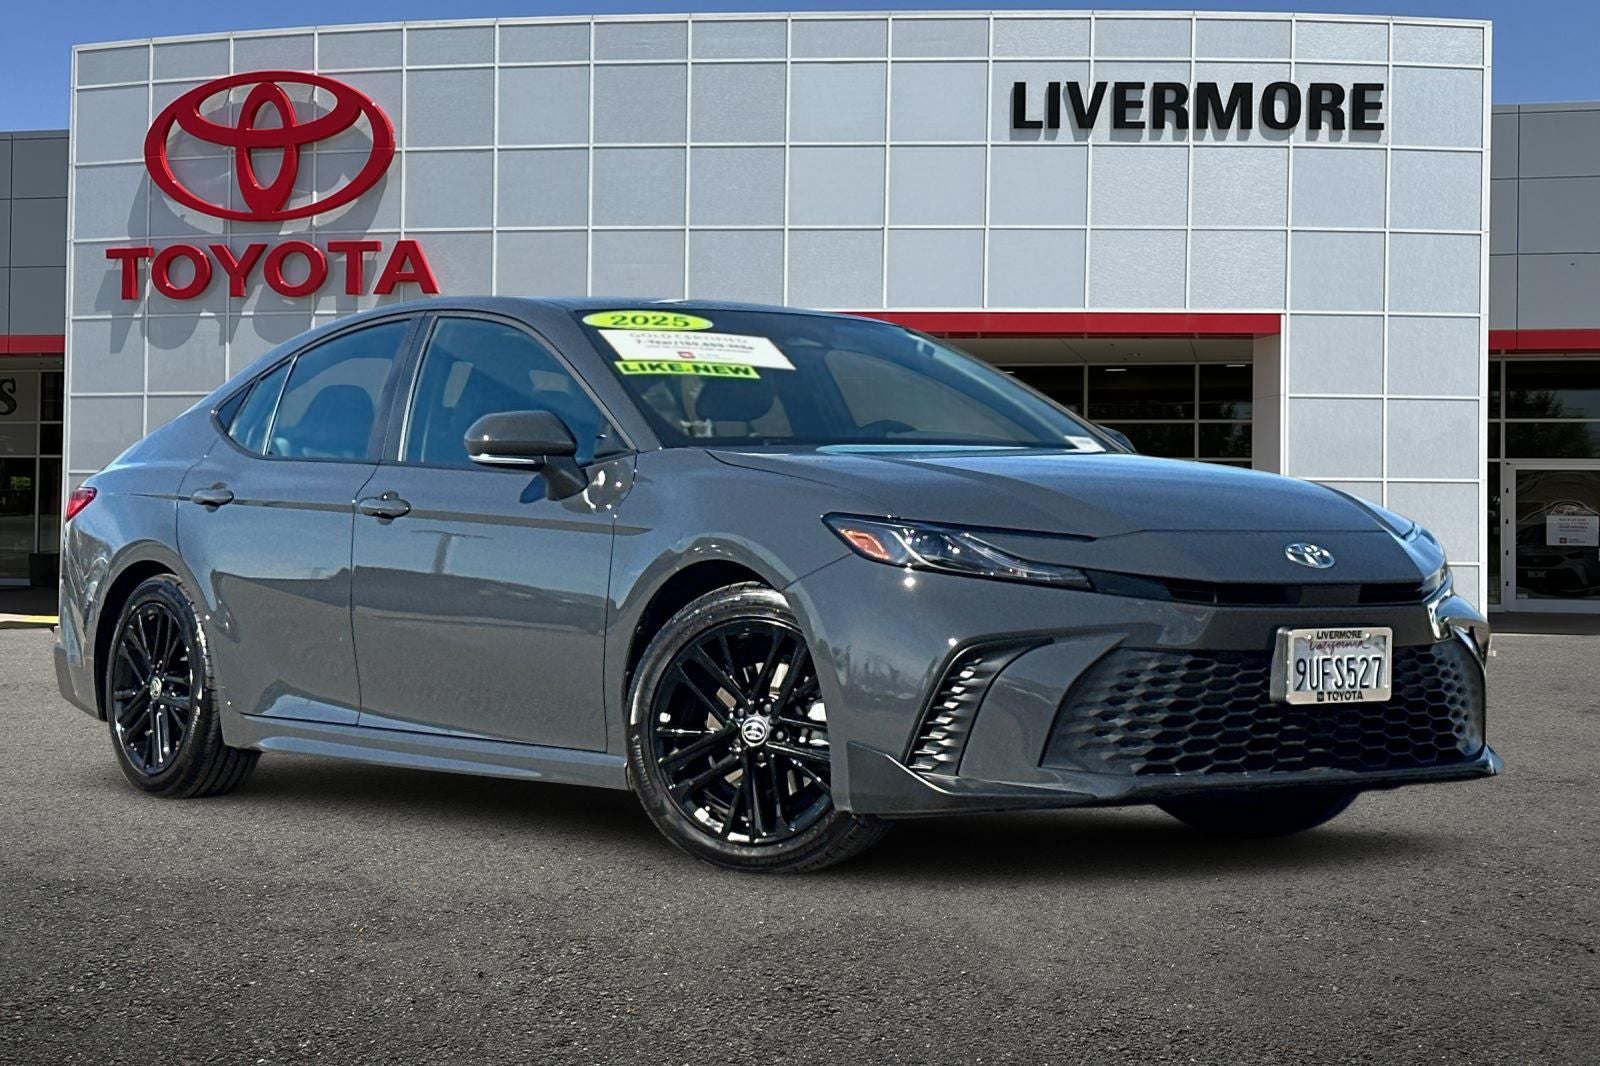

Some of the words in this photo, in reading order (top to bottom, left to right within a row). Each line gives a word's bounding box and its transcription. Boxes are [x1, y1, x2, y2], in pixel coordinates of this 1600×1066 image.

[1012, 81, 1385, 131] LIVERMORE
[105, 240, 440, 300] TOYOTA
[610, 315, 690, 327] 2025
[621, 362, 683, 372] LIKE
[691, 364, 751, 375] NEW
[1316, 630, 1363, 639] LIVERMORE
[1309, 640, 1370, 655] California
[1296, 657, 1382, 691] 9UFS527
[1326, 690, 1363, 701] TOYOTA
